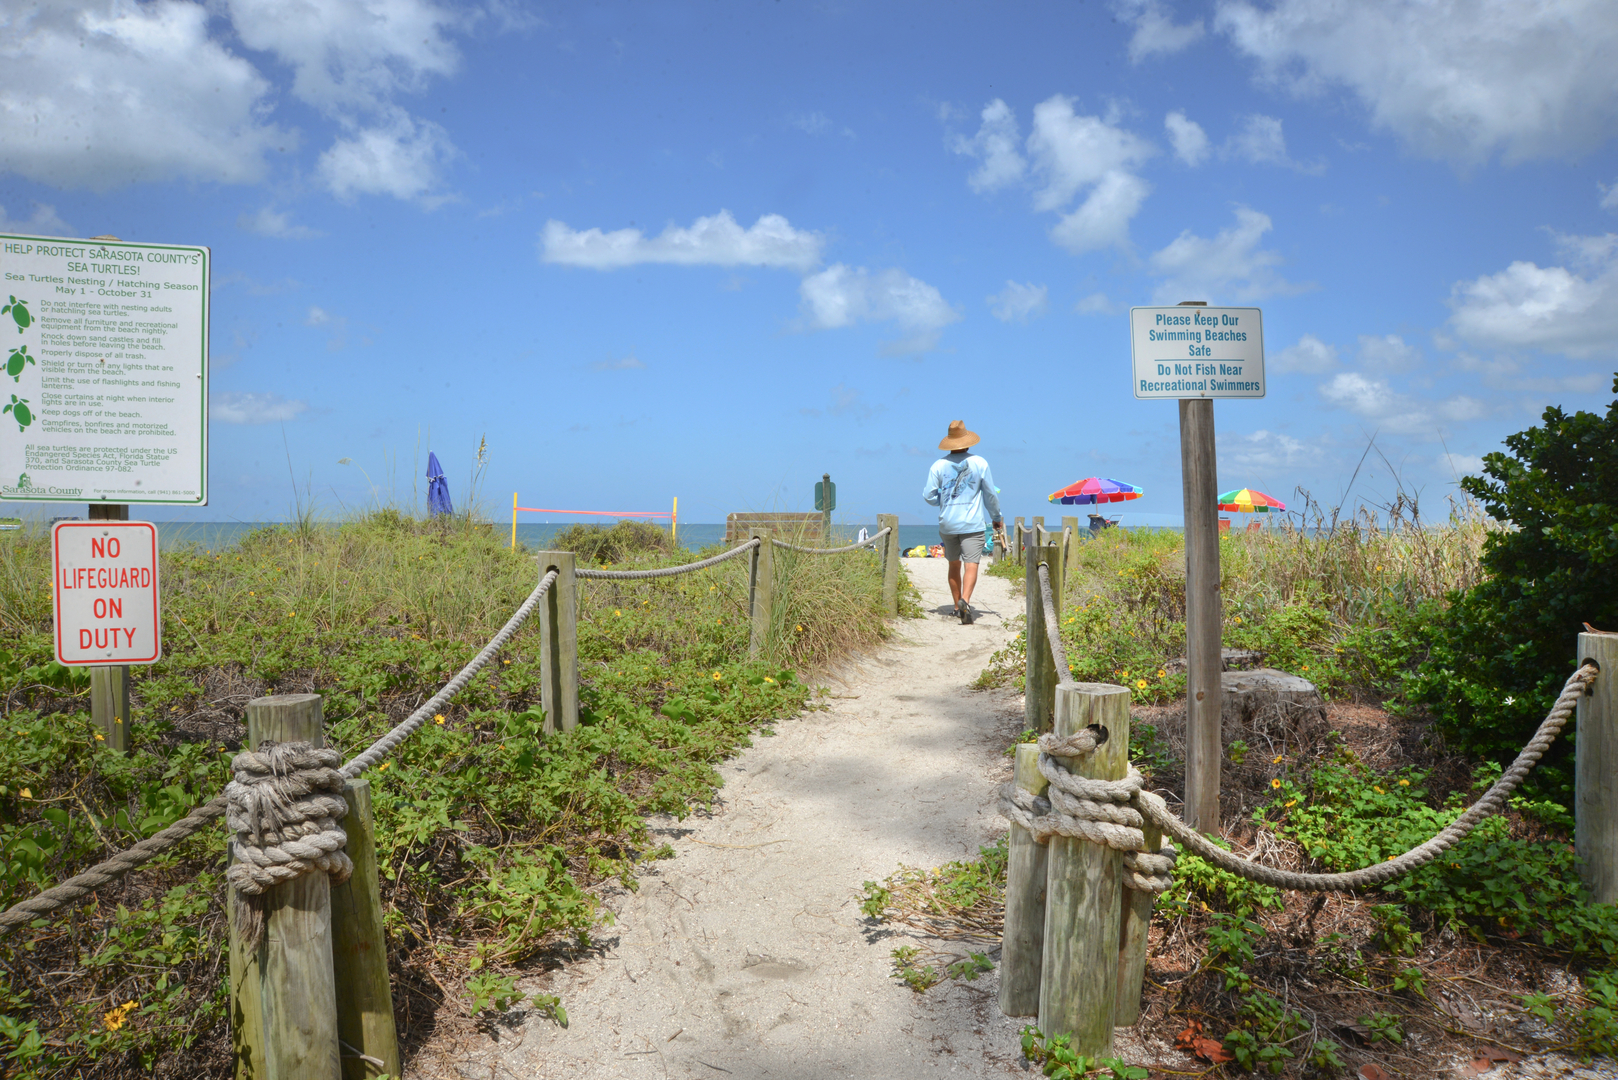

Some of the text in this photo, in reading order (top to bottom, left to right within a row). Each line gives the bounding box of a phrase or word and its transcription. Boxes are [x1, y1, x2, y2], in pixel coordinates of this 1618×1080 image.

[5, 243, 198, 264] HELP PROTECT SARASOTA COUNTY'S
[68, 262, 140, 275] SEA TURTLES!
[29, 274, 64, 283] Turtles
[68, 277, 105, 287] Nesting
[117, 280, 160, 290] Hatching
[56, 286, 76, 295] May
[98, 288, 137, 297] October
[52, 306, 85, 315] hatchling
[136, 320, 178, 328] recreational
[1156, 314, 1239, 328] Please Keep Our
[41, 323, 81, 331] equipment
[142, 327, 167, 335] nightly.
[1149, 329, 1247, 343] Swimming Beaches
[41, 349, 72, 358] Properly
[1189, 344, 1211, 356] Safe
[1158, 364, 1242, 375] Do Not Fish Near
[1140, 379, 1259, 391] Recreational Swimmers
[2, 485, 83, 496] Sarasota County
[92, 538, 120, 558] NO
[64, 568, 150, 589] LIFEGUARD
[94, 598, 122, 618] ON
[80, 628, 136, 649] DUTY
